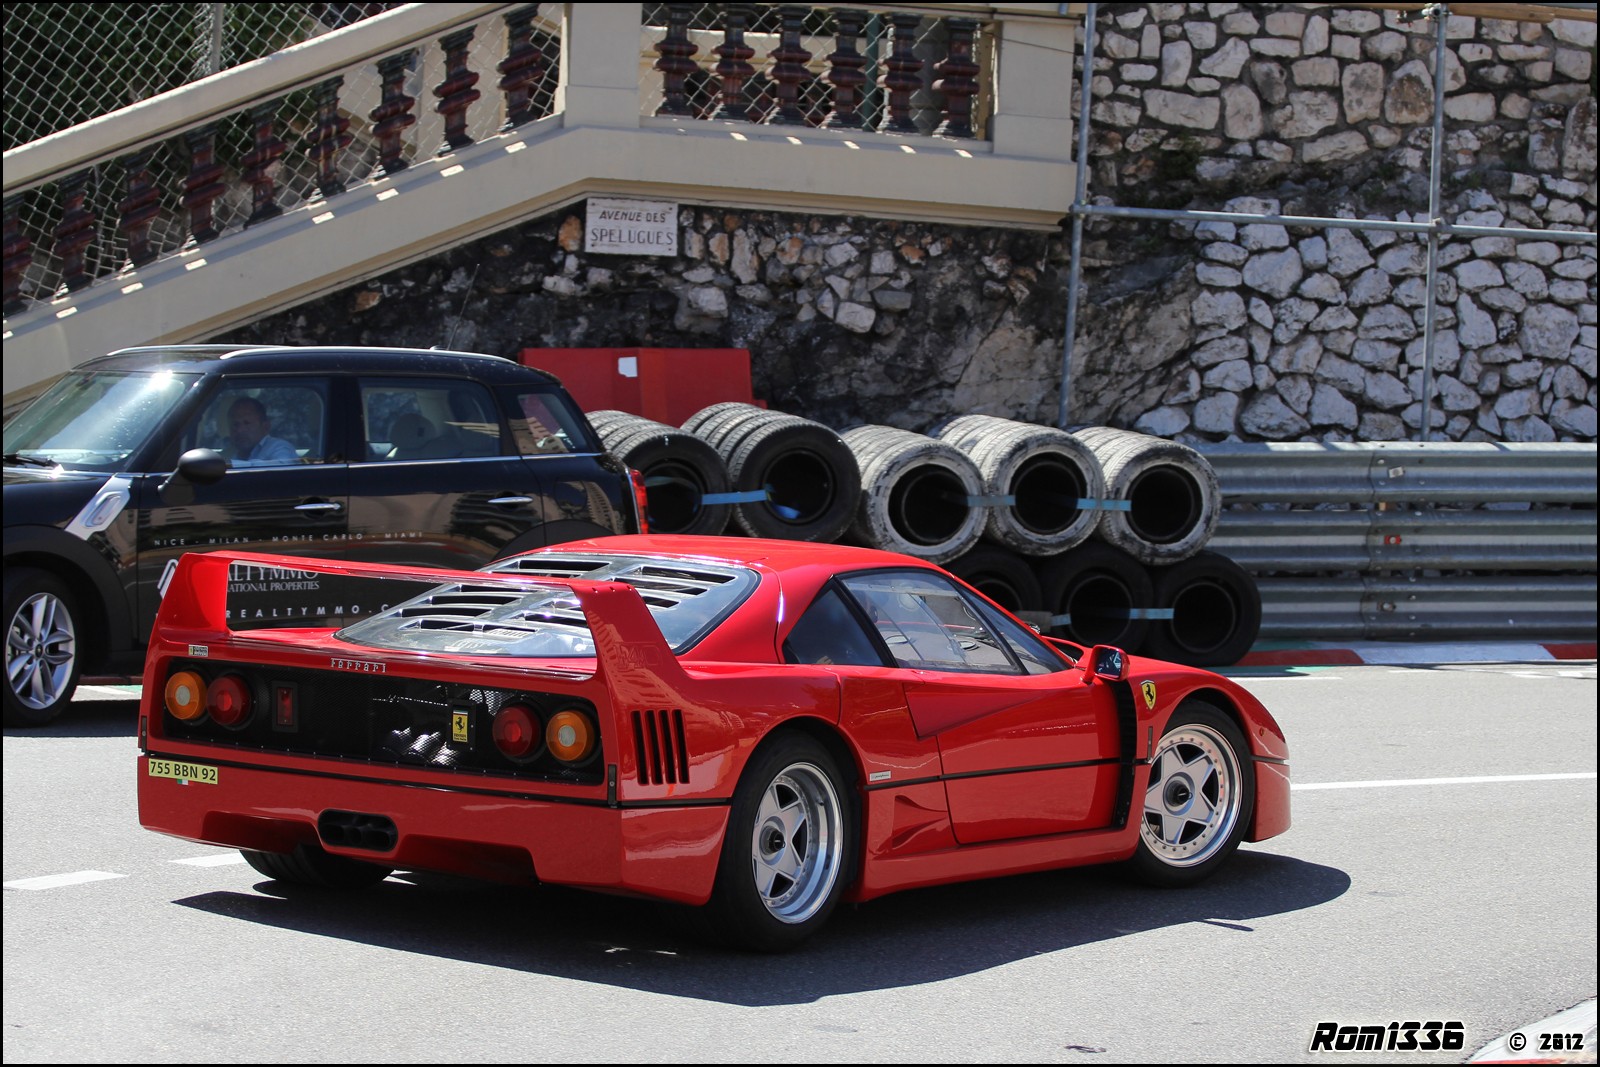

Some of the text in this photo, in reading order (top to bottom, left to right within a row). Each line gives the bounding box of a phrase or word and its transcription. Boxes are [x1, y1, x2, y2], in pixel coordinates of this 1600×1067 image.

[599, 210, 667, 223] AVENUE DES
[590, 227, 674, 246] SPELUGUES
[154, 538, 185, 546] NICE
[208, 536, 249, 545] MILAN
[271, 534, 313, 543] MONTE
[322, 533, 363, 541] CARLO
[384, 531, 423, 539] MIAMI
[228, 580, 320, 593] ATIONAL PROPERTIES
[330, 657, 386, 673] Ferrari
[150, 761, 217, 781] 755 BBN 92
